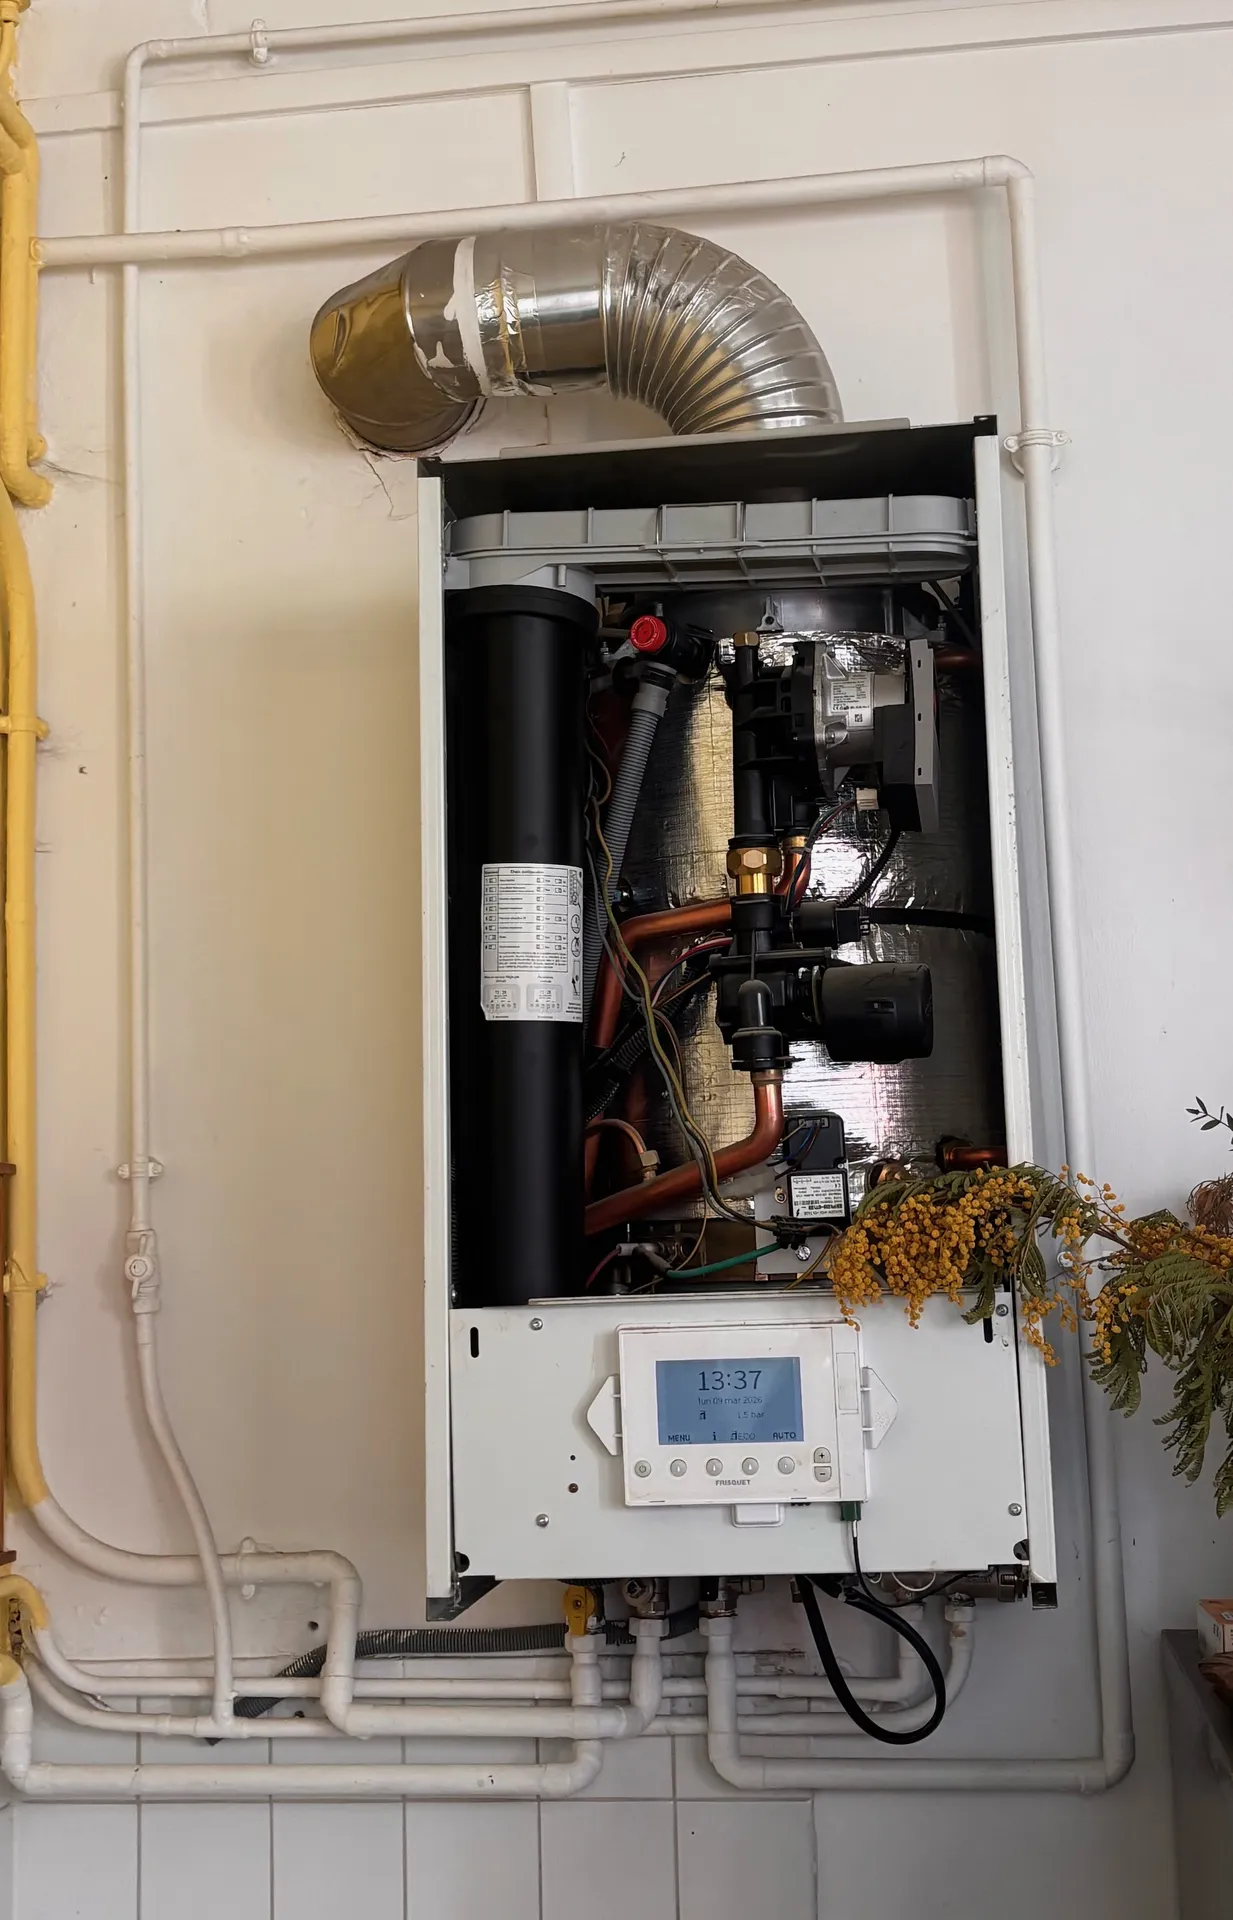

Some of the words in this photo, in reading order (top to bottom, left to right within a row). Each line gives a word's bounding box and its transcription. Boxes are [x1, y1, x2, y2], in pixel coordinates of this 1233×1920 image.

[698, 1370, 762, 1391] 13:37
[698, 1397, 711, 1405] lun
[712, 1397, 723, 1405] 09
[724, 1397, 741, 1405] mar
[742, 1396, 763, 1404] 2026
[750, 1411, 765, 1419] bar
[667, 1433, 691, 1442] MENU
[772, 1431, 797, 1440] AUTO
